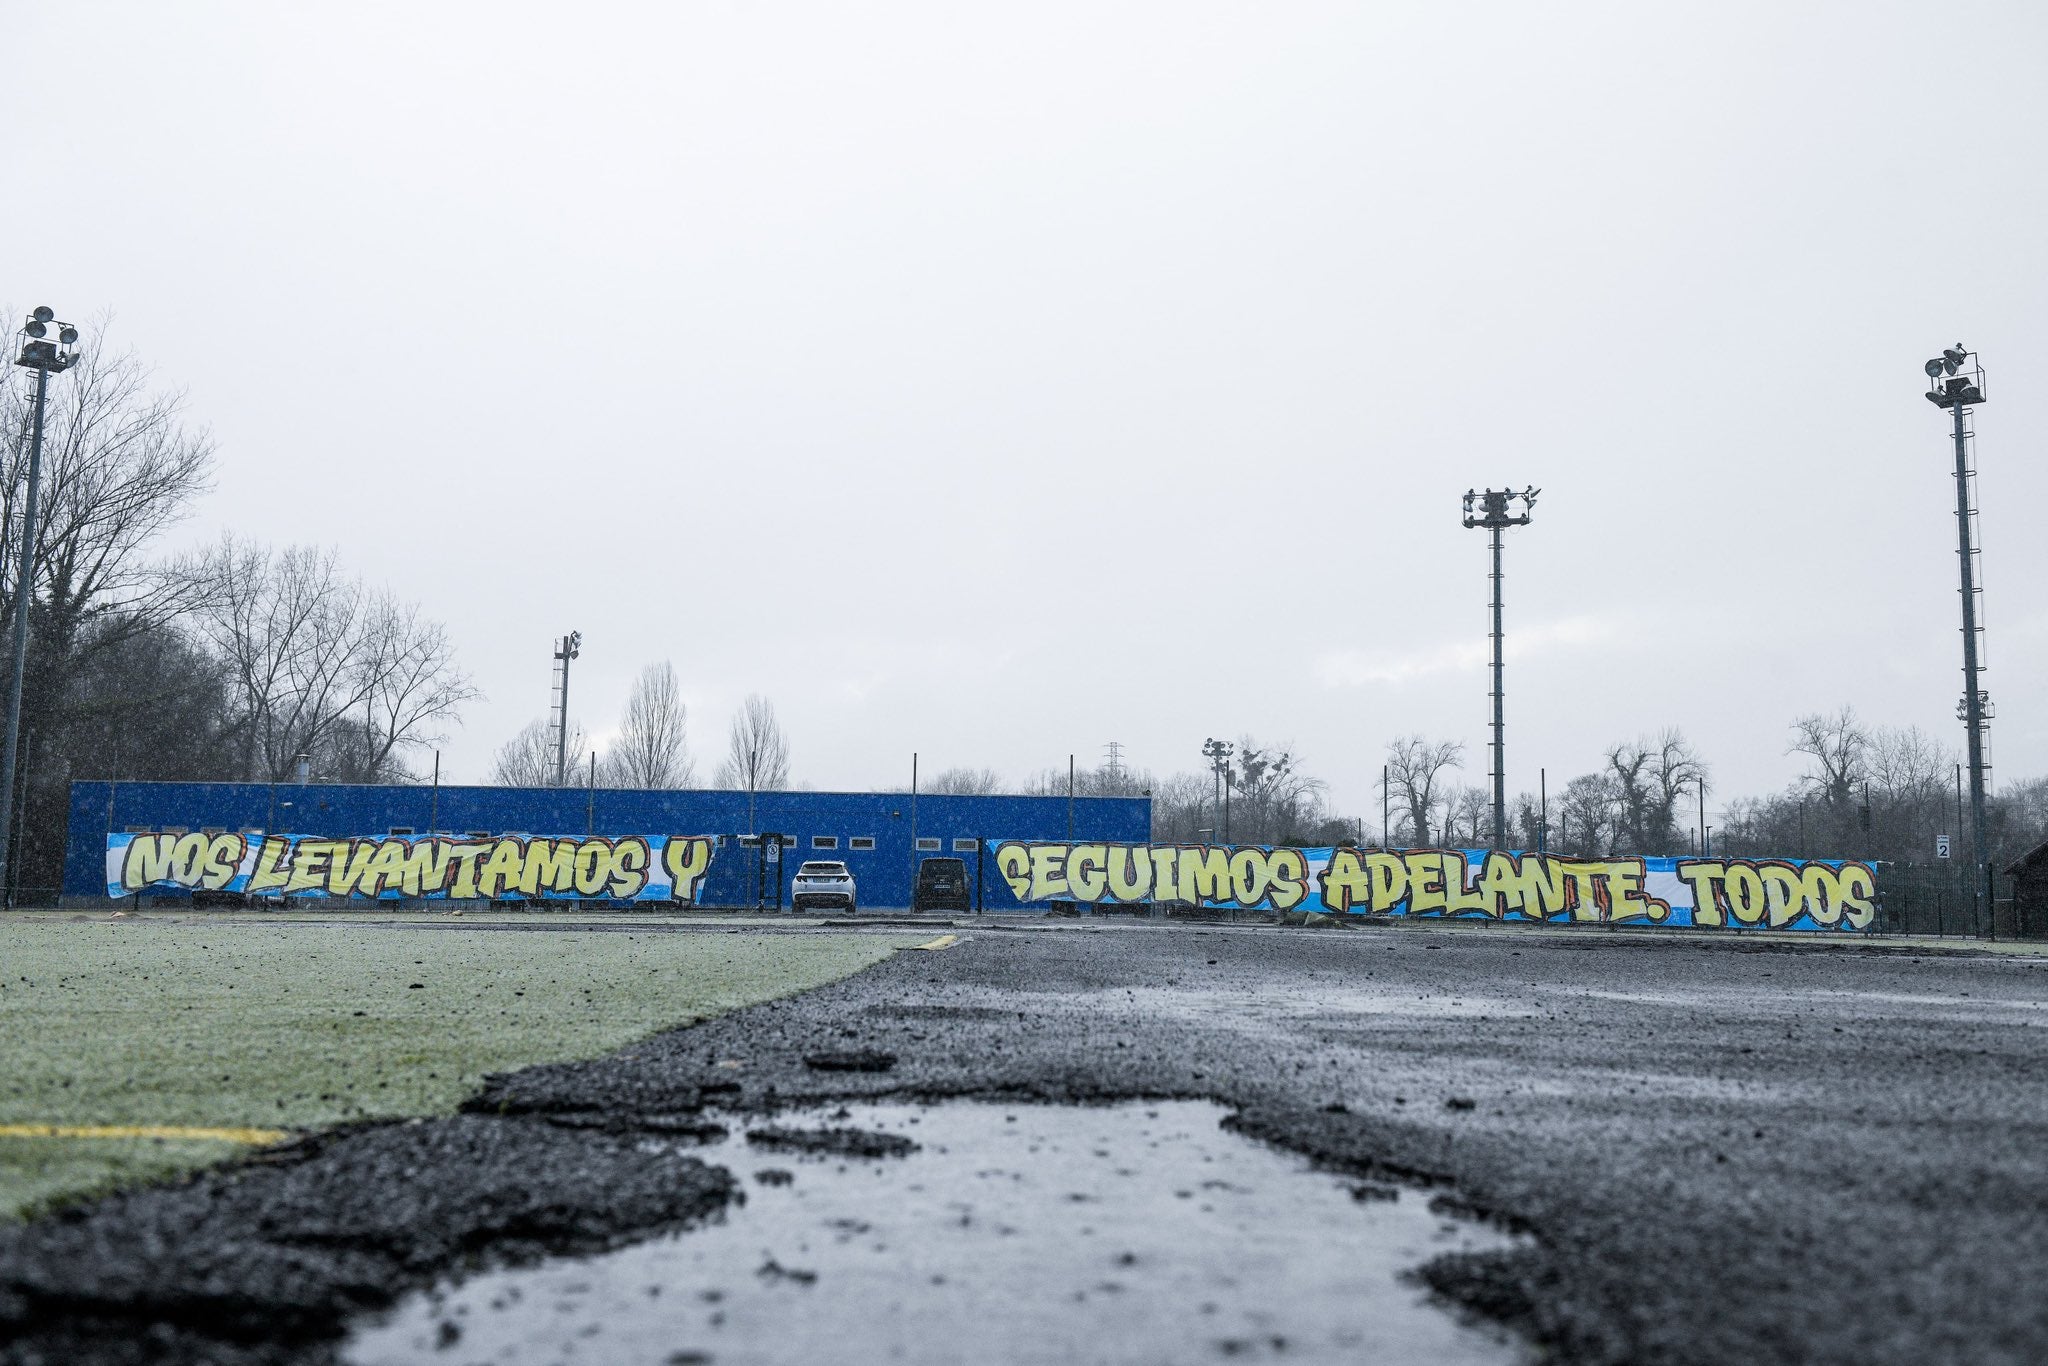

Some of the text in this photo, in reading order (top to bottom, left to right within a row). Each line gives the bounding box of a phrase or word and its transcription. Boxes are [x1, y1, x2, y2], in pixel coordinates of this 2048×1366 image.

[122, 832, 712, 900] NOS LEVANTAMOS Y
[1939, 845, 1948, 857] 2
[996, 841, 1877, 930] SEGUIMOS ADELANTE. TODOS
